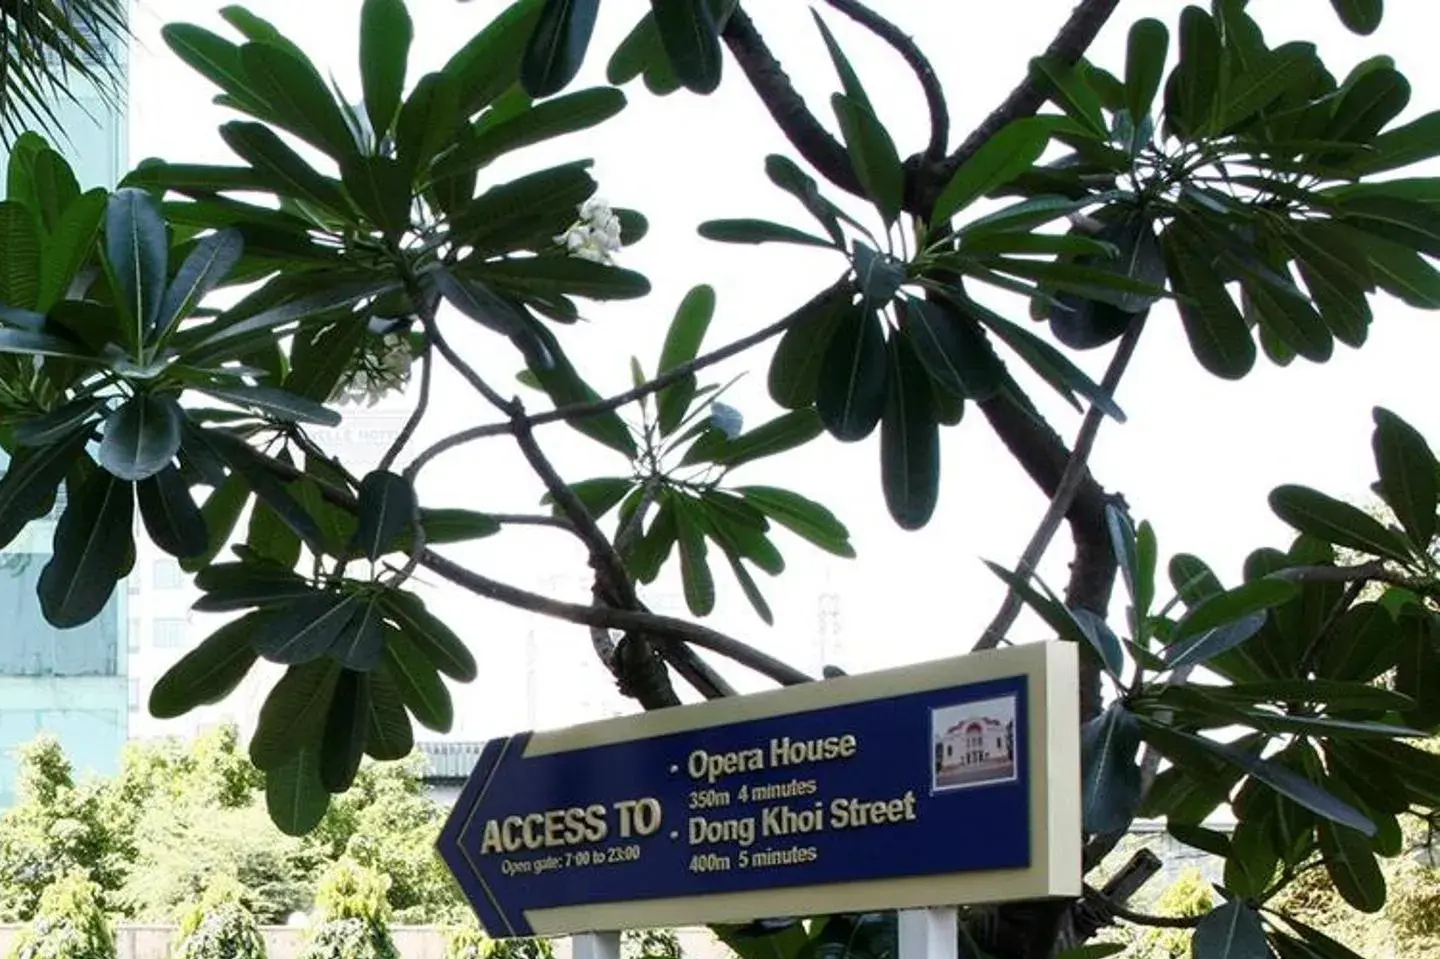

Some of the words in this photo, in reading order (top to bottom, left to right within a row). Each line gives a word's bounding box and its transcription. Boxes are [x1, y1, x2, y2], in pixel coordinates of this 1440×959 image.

[688, 748, 764, 783] Opera
[770, 734, 857, 767] House
[688, 790, 730, 809] 350m
[737, 784, 748, 803] 4
[752, 779, 817, 801] minutes
[480, 804, 608, 855] ACCESS
[613, 797, 661, 838] TO
[689, 816, 755, 846] Dong
[762, 802, 823, 836] Khoi
[830, 790, 916, 828] Street
[501, 858, 531, 876] Open
[533, 856, 563, 875] gate:
[592, 849, 606, 864] to
[608, 845, 640, 862] 23:00
[689, 854, 730, 873] 400m
[738, 850, 749, 868] 5
[752, 845, 817, 867] minutes
